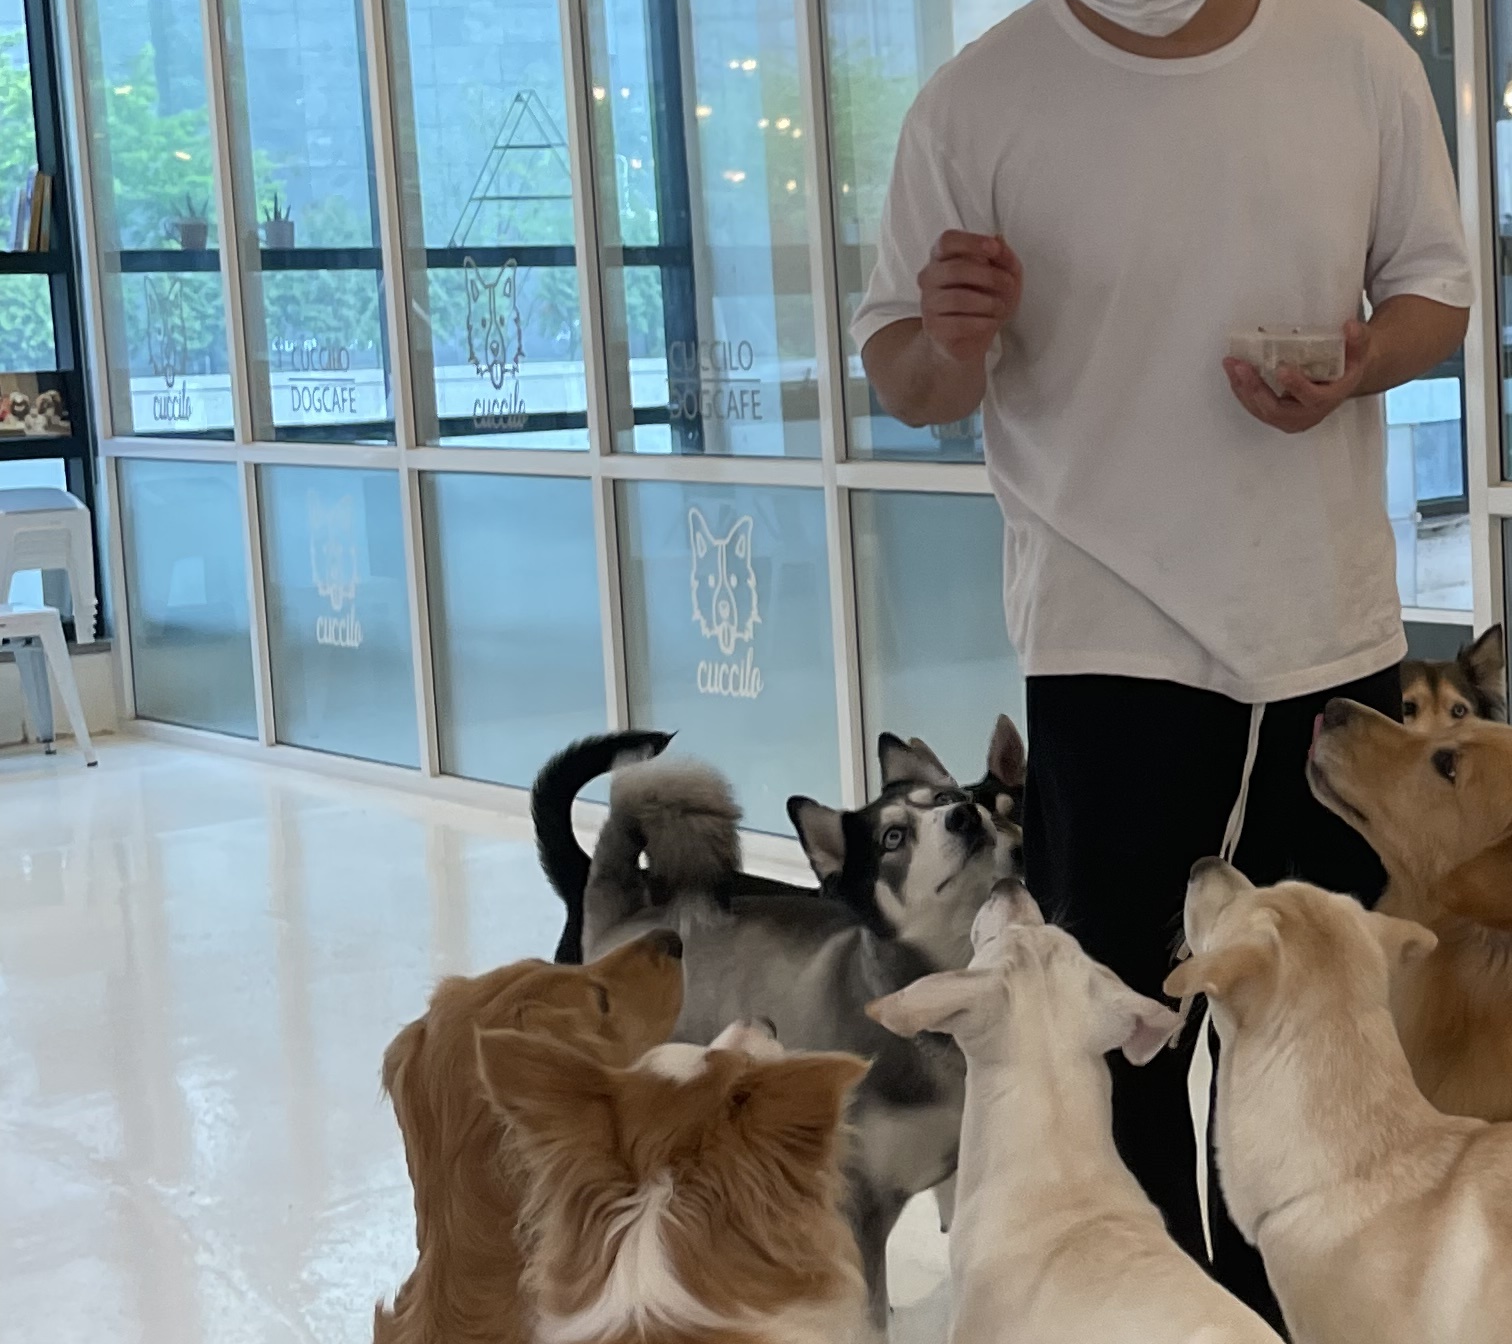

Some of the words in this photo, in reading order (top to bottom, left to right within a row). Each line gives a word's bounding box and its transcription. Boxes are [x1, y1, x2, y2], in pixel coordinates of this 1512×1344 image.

[668, 339, 755, 372] CUCCILO
[153, 380, 192, 422] cuccilo
[290, 386, 357, 414] DOGCAFE
[473, 379, 527, 429] cuccilo
[668, 387, 763, 421] DOGCAFE
[315, 605, 364, 648] cuccilo
[697, 647, 764, 699] cuccilo
